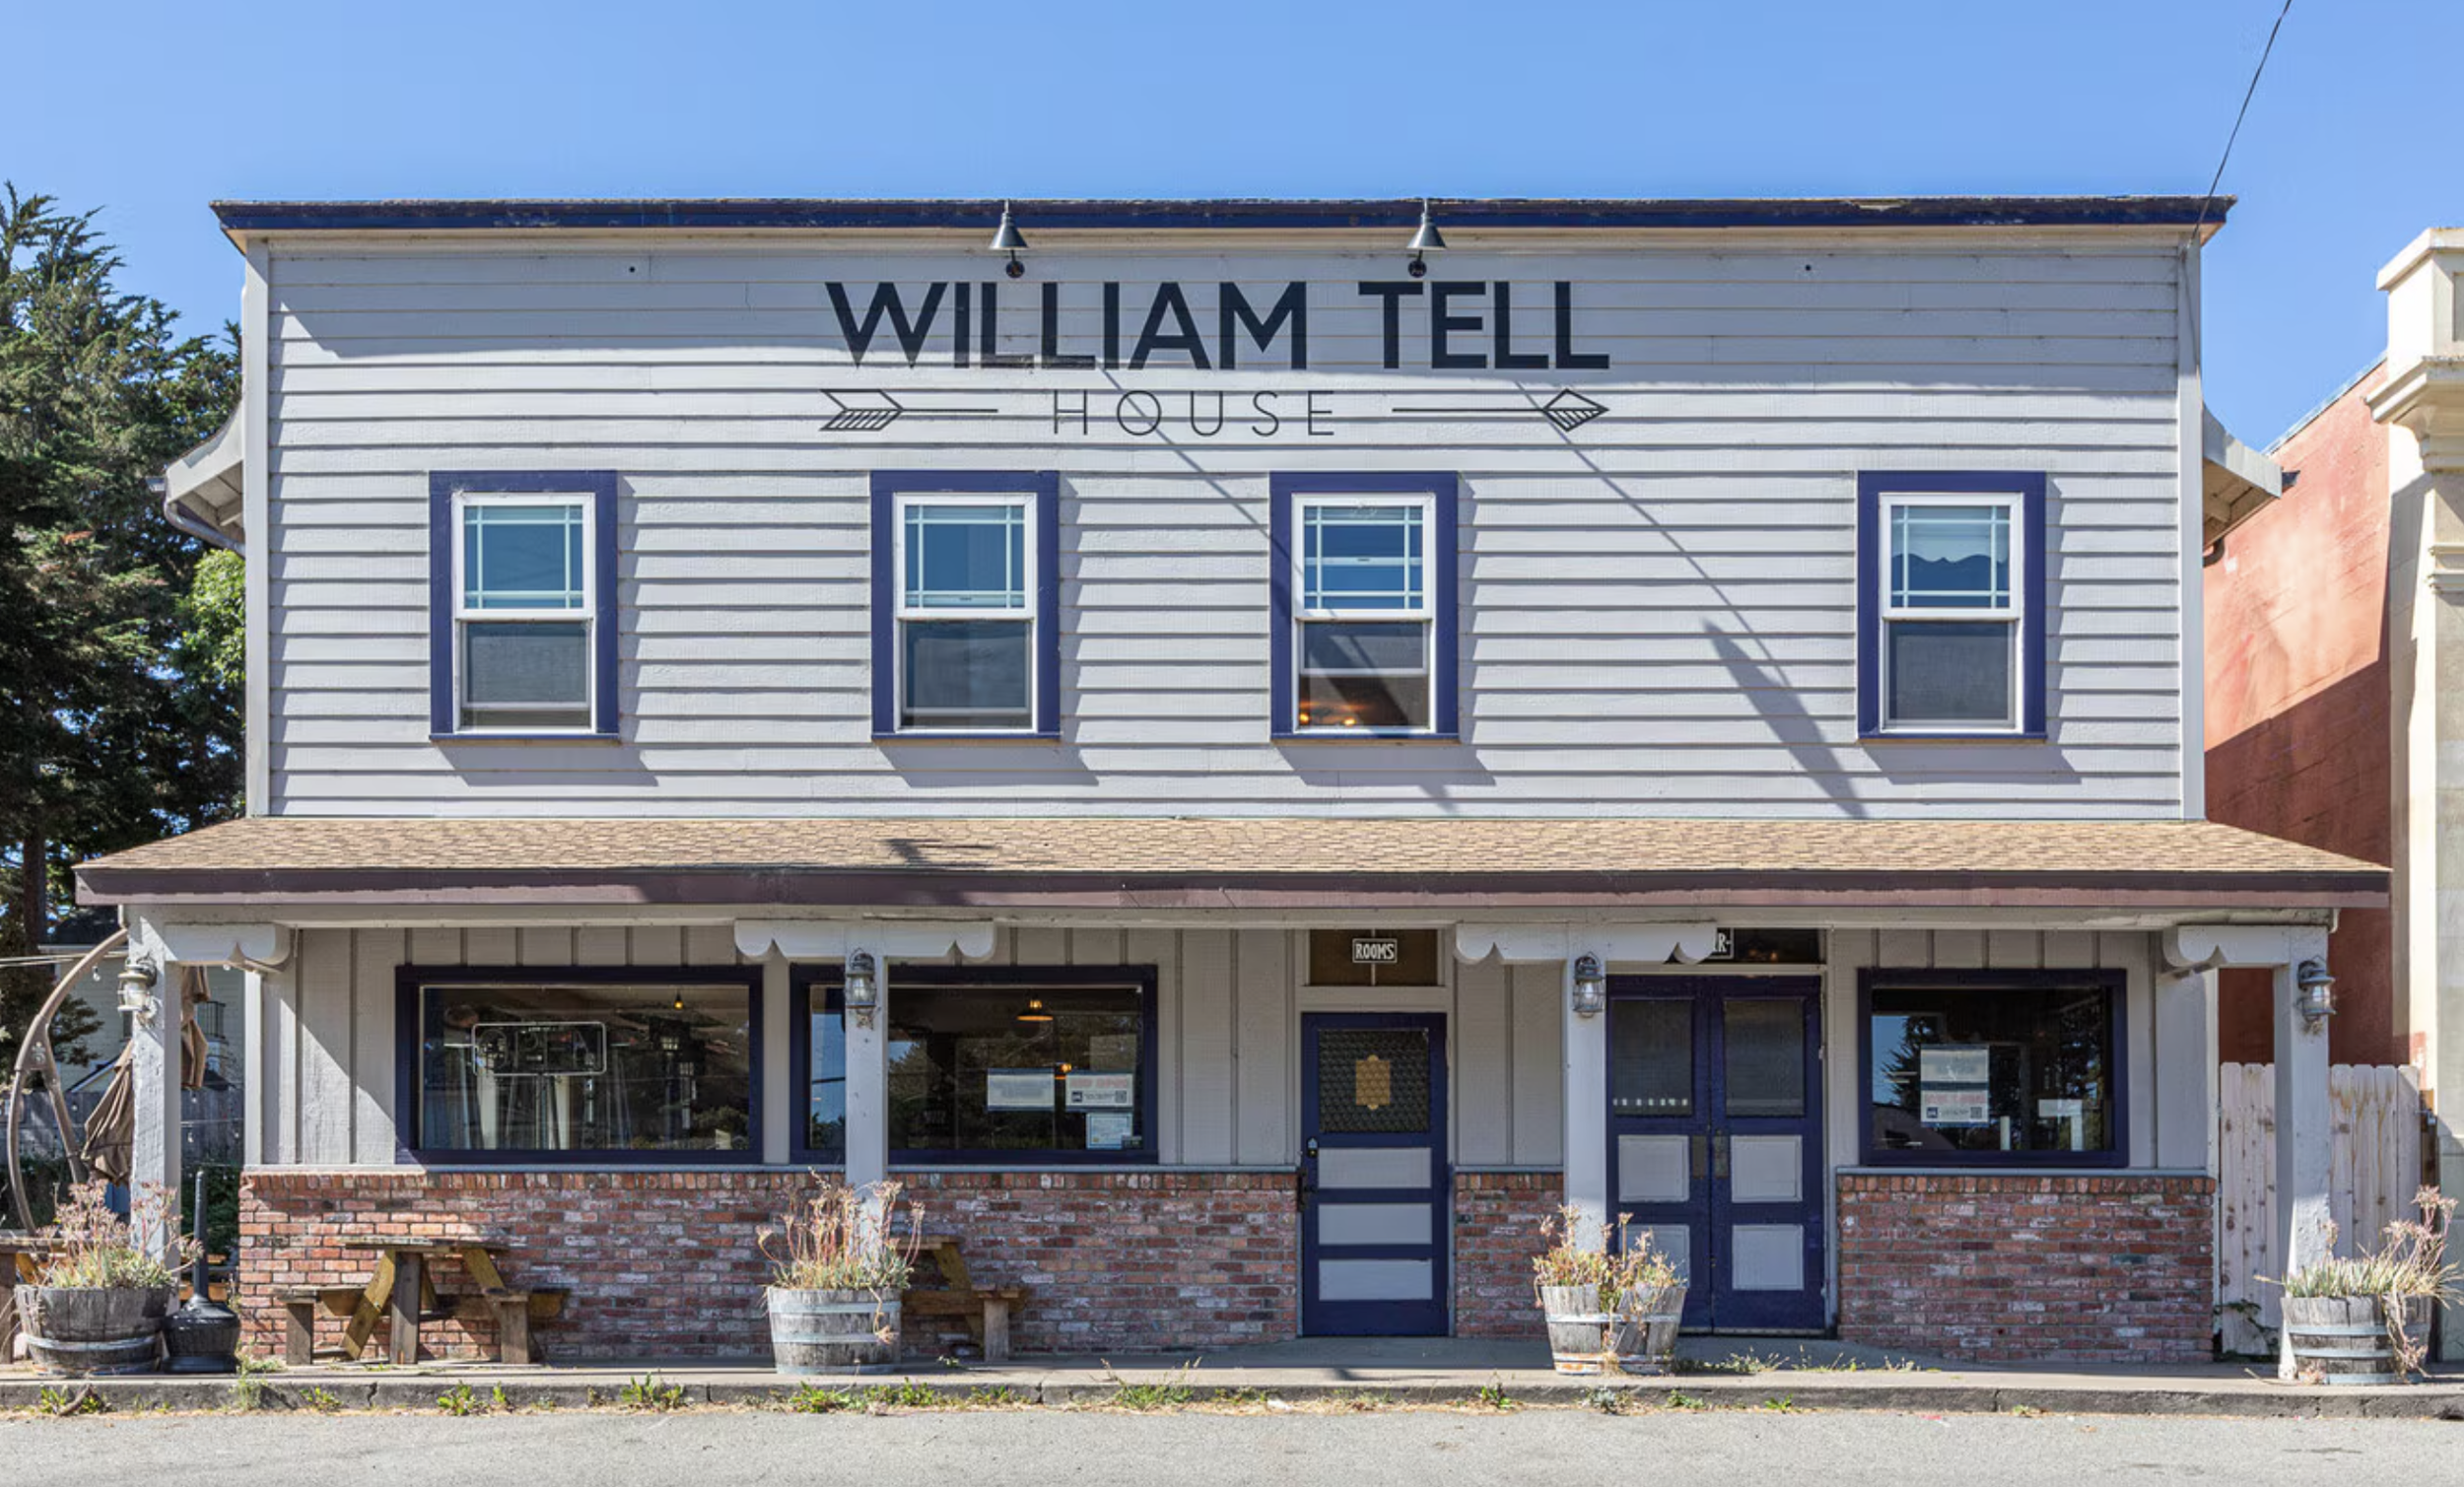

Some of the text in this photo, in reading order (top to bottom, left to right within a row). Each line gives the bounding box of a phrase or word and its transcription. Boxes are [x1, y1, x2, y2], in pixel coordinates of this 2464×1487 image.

[825, 281, 1609, 370] WILLIAM TELL
[1055, 390, 1335, 436] HOUSE
[1355, 943, 1395, 960] ROOMS
